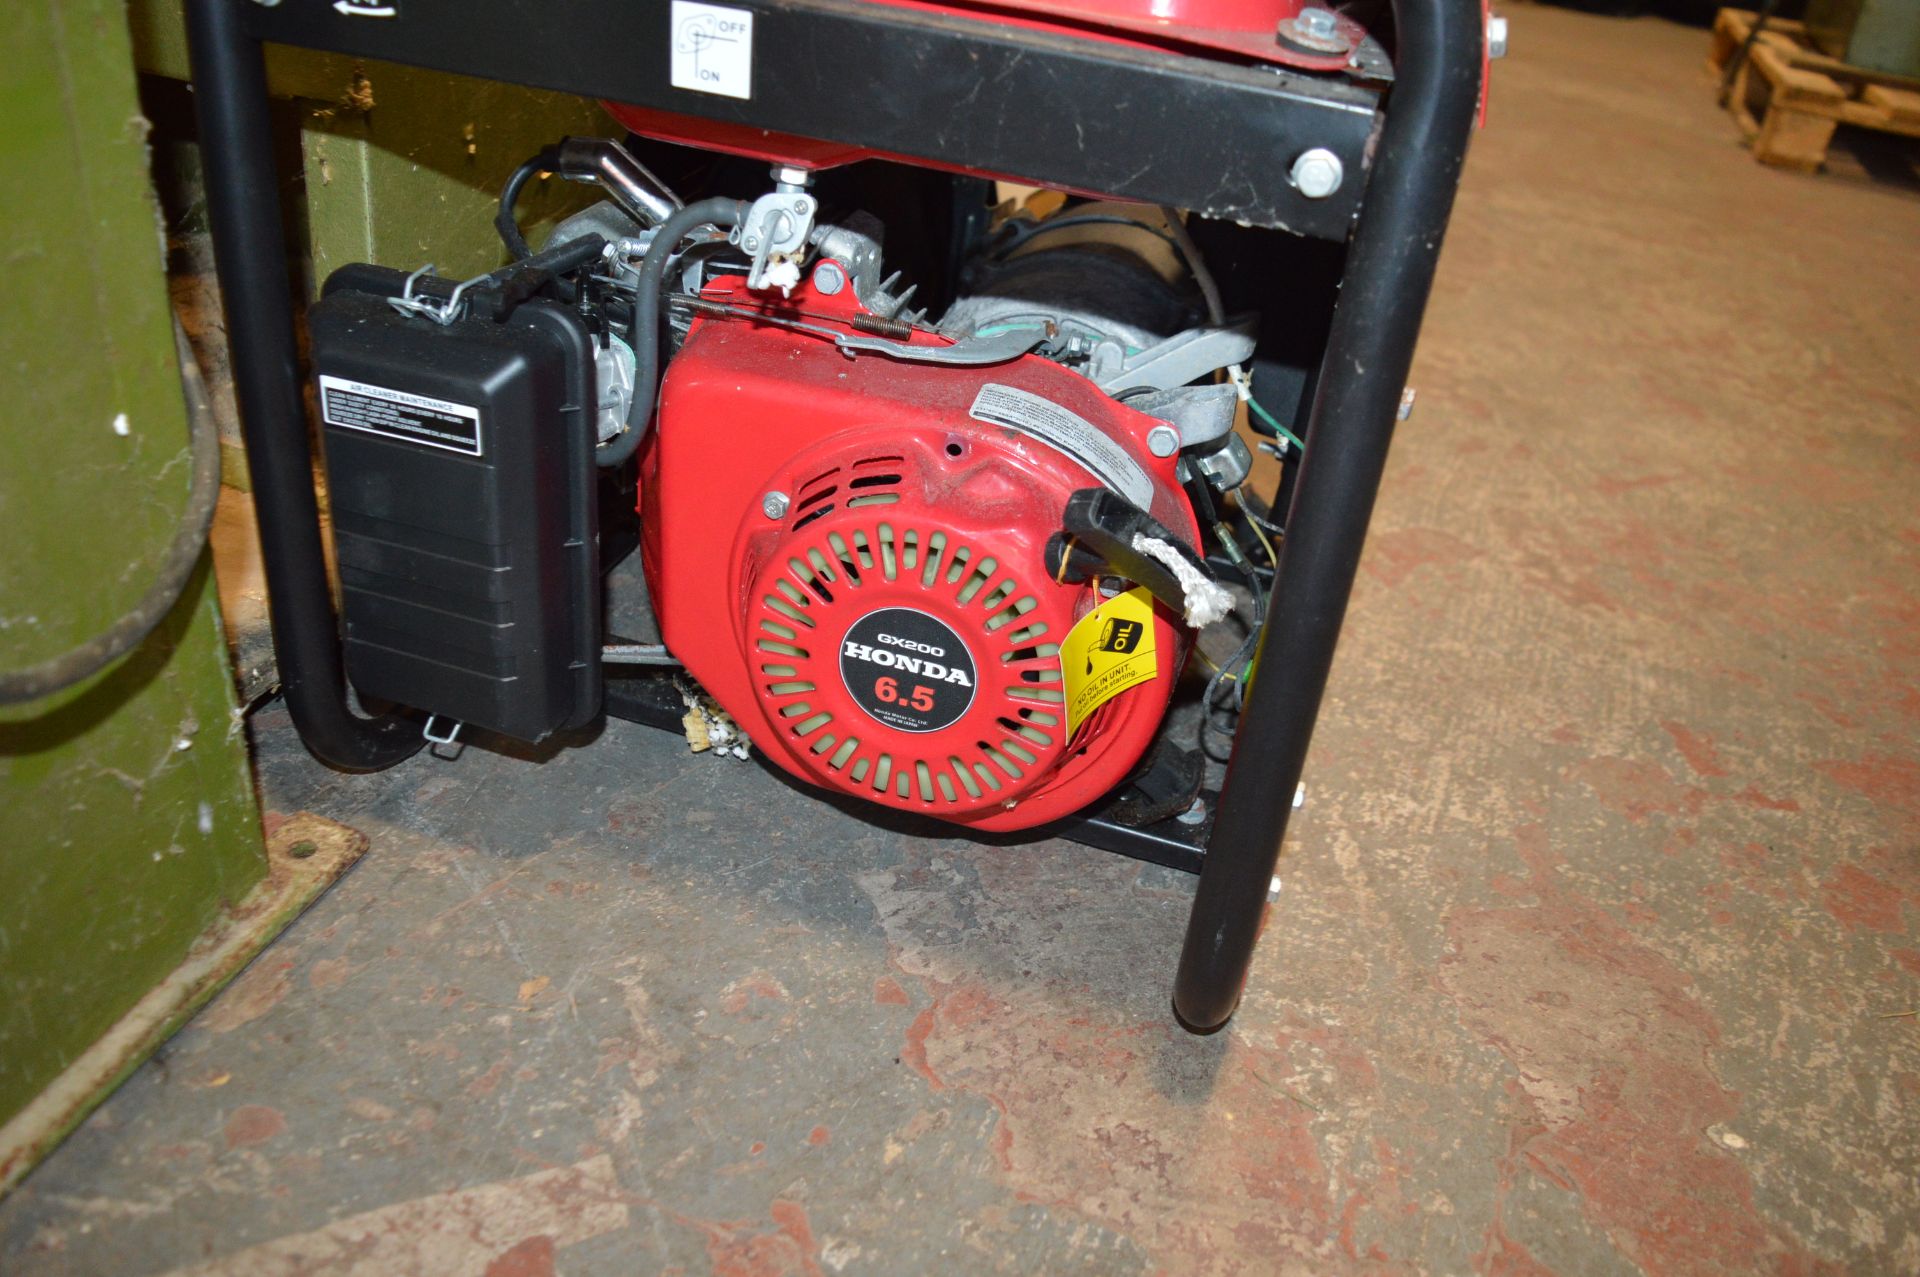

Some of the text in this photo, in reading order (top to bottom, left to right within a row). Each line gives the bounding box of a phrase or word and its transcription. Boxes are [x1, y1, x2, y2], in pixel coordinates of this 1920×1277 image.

[719, 20, 747, 34] OFF
[700, 69, 720, 82] ON
[350, 383, 362, 391] AIR
[364, 386, 397, 400] CLEANER
[399, 394, 453, 411] MAINTENANCE
[877, 633, 945, 657] GX200
[1114, 623, 1133, 650] OIL
[844, 641, 972, 687] HONDA
[875, 676, 935, 712] 6.5
[1078, 663, 1132, 705] NO OIL IN UNIT.
[1090, 685, 1109, 701] before
[1110, 670, 1138, 687] starting.
[874, 708, 891, 716] Honda
[891, 712, 907, 720] Motor
[903, 720, 918, 728] JAPAN
